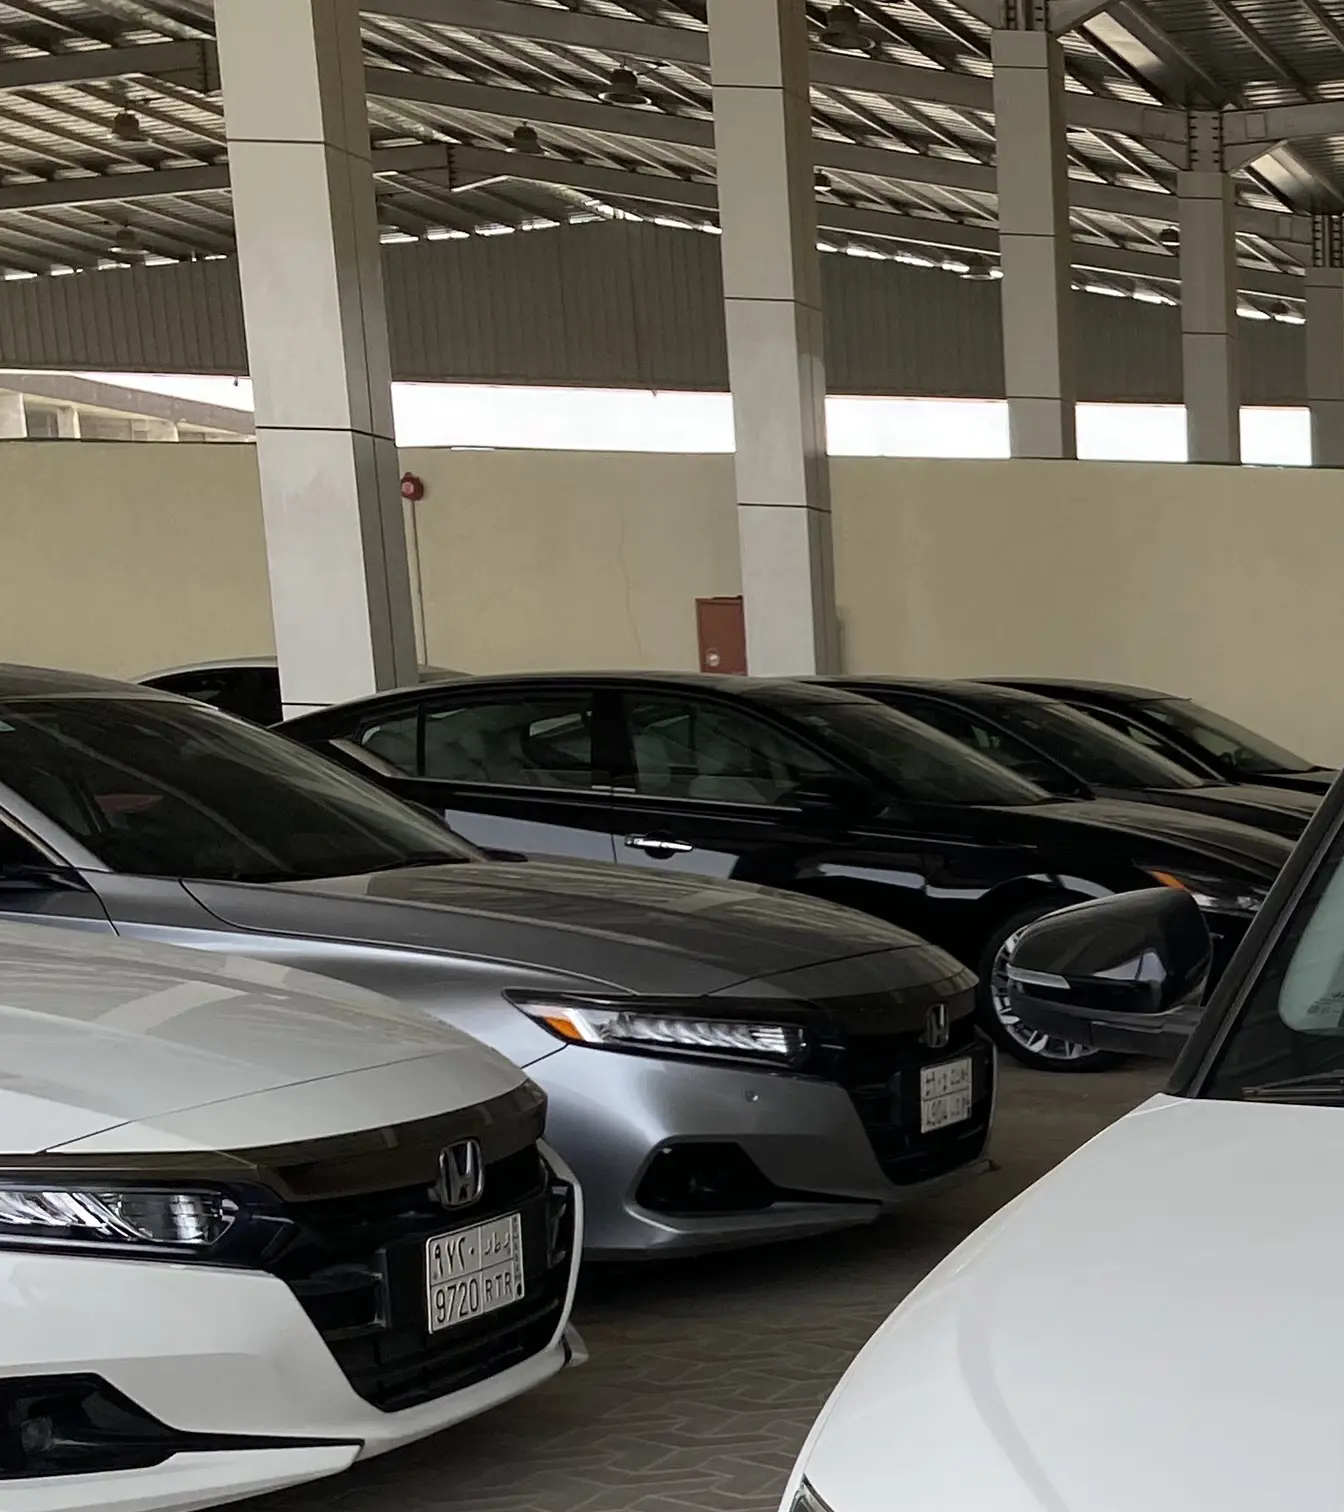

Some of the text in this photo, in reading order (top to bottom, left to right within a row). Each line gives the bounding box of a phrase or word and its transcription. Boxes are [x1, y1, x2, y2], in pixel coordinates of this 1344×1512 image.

[433, 1236, 476, 1277] ٩٧٢٠
[435, 1272, 512, 1323] 9720 RTR
